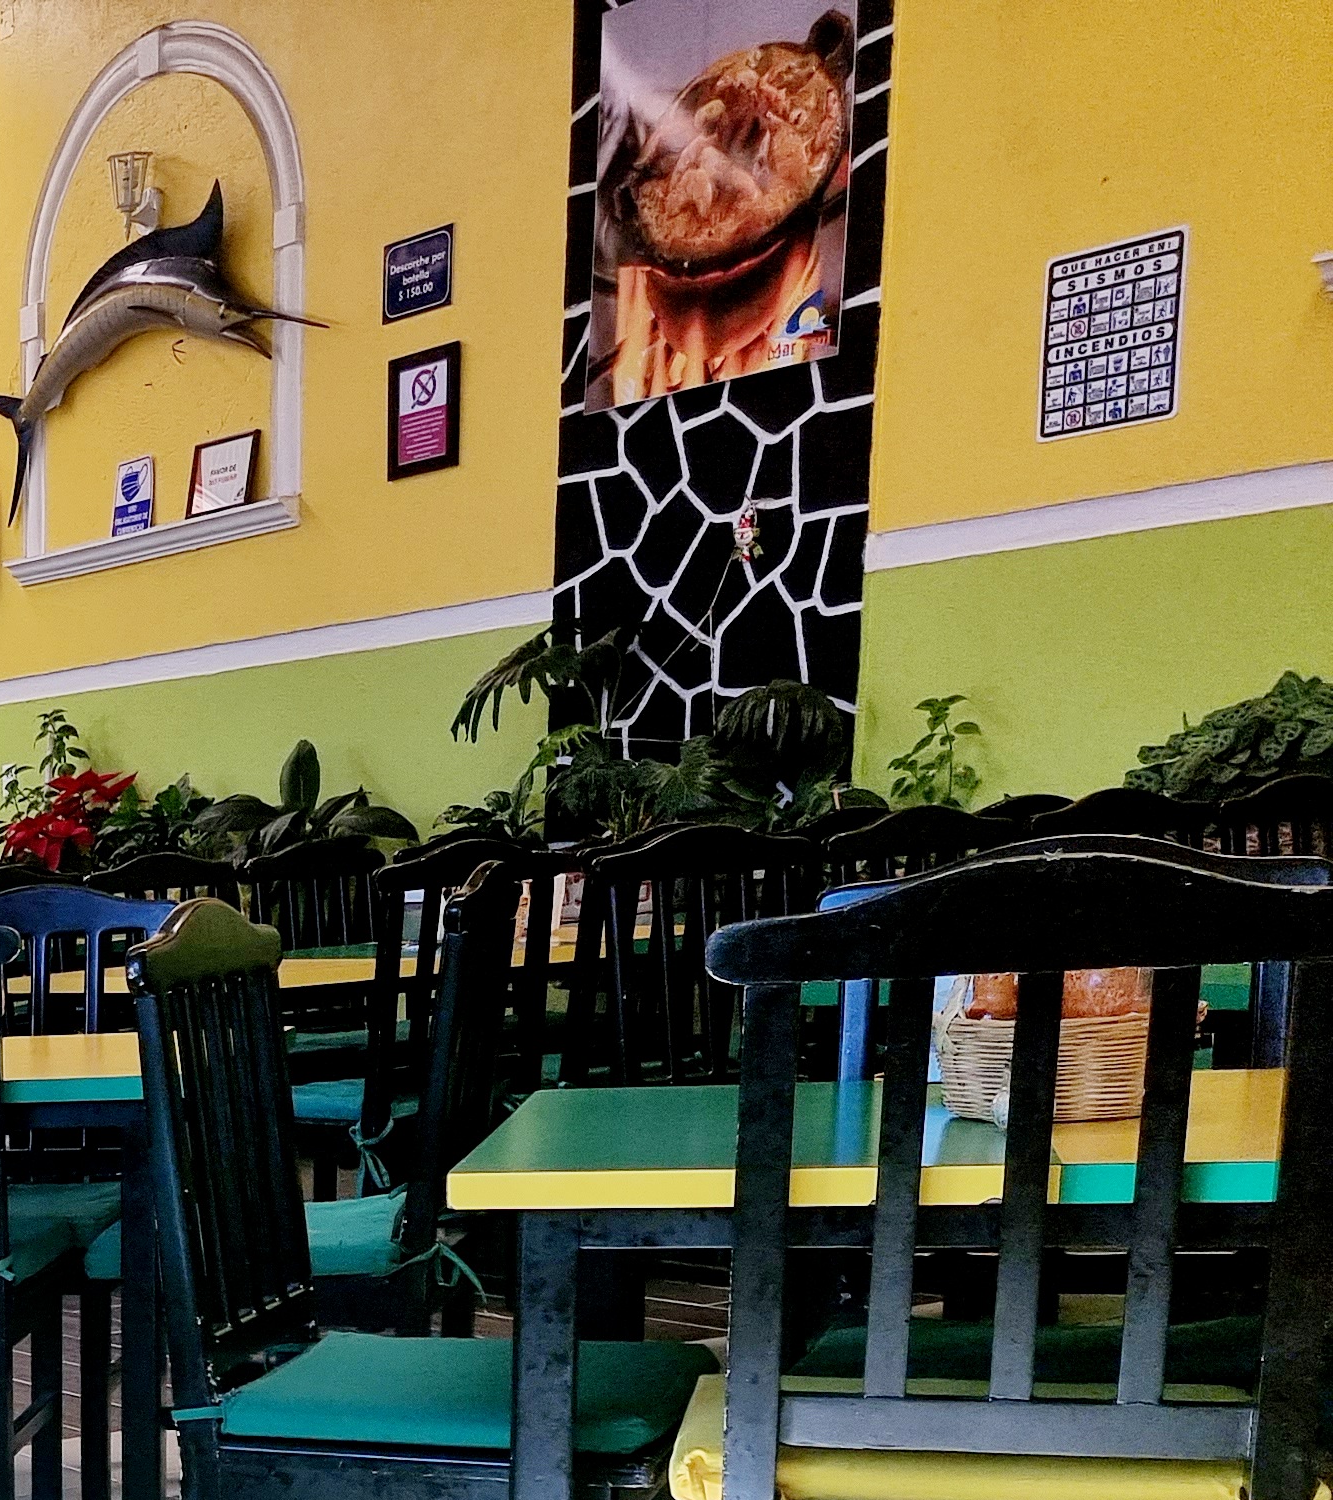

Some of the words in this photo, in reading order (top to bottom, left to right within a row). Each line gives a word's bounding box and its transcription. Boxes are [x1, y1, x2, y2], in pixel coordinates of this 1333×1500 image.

[390, 255, 430, 276] Descorche
[432, 250, 446, 265] por
[1061, 261, 1087, 274] QUE
[1094, 248, 1140, 267] HACER
[403, 270, 430, 286] botella
[1067, 259, 1162, 292] SISMOS
[1055, 326, 1166, 361] INCENDIOS
